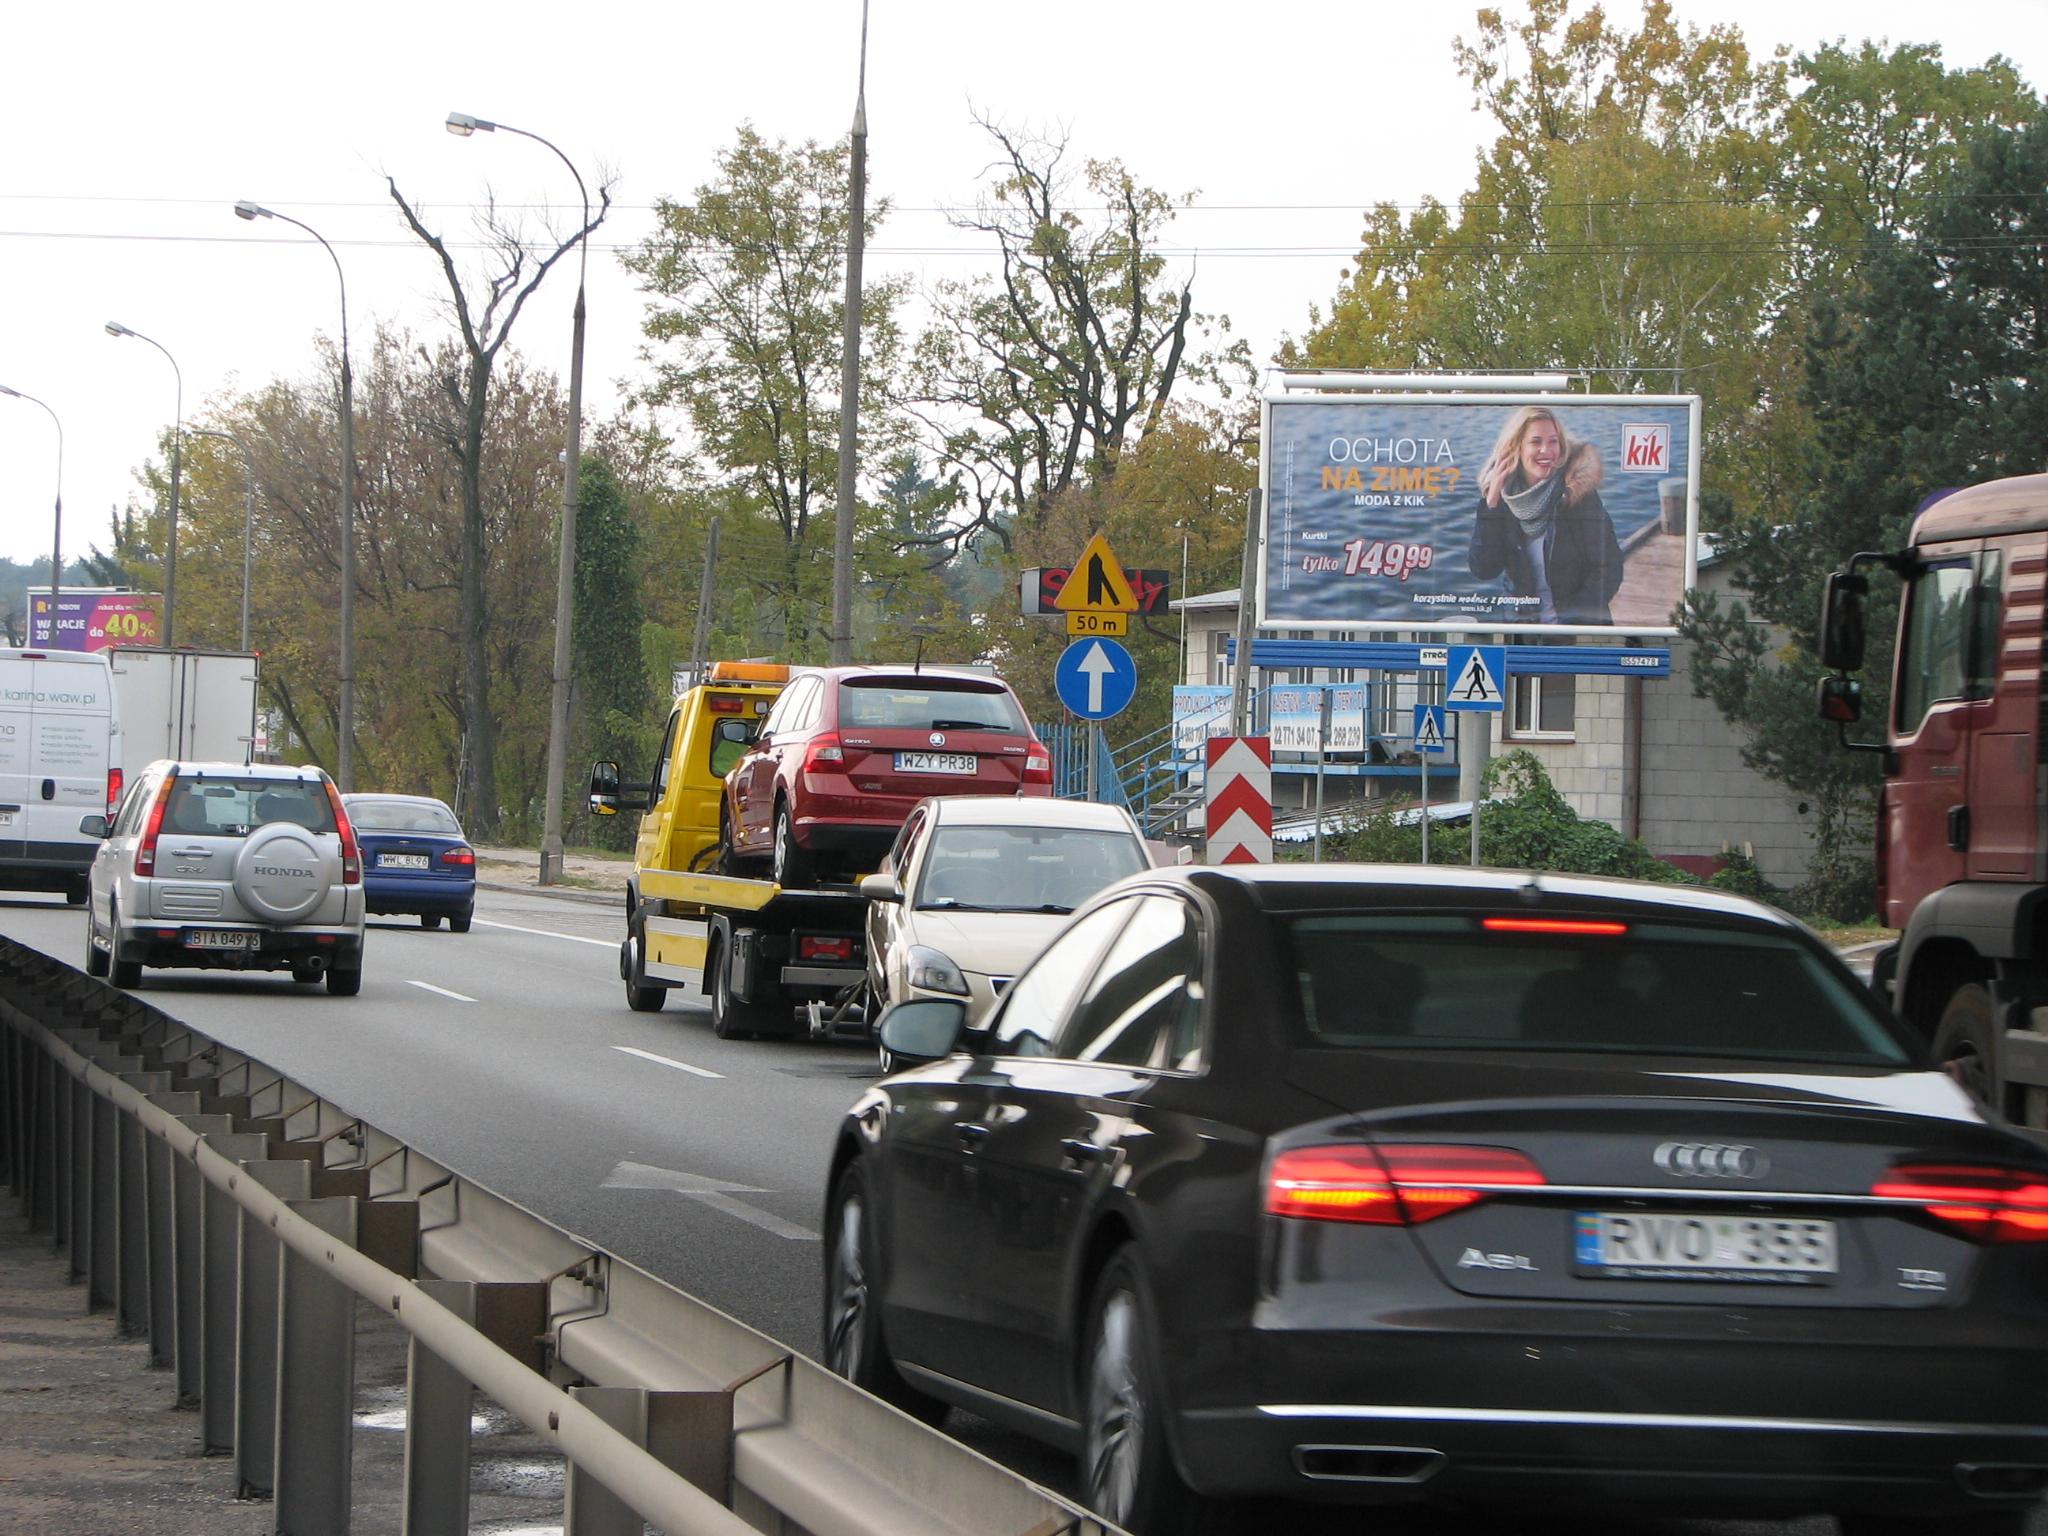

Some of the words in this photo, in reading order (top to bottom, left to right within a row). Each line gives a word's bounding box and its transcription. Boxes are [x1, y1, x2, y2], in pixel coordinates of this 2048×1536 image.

[1329, 437, 1454, 463] OCHOTA
[1626, 430, 1664, 466] kik
[1321, 466, 1363, 490] NA
[1371, 467, 1461, 498] ZIMĘ?
[1354, 495, 1391, 506] MODA
[1393, 496, 1401, 506] Z
[1404, 496, 1425, 506] KIK
[1302, 531, 1328, 540] Kurtki
[1302, 554, 1339, 574] tylko
[1413, 593, 1456, 605] korzystnie
[1490, 597, 1497, 605] z
[1077, 615, 1098, 631] 50
[1103, 621, 1117, 631] m
[89, 626, 104, 638] do
[904, 753, 934, 768] WZY
[939, 755, 975, 770] PR38
[254, 866, 315, 878] HONDA
[193, 931, 217, 945] BIA
[1606, 1216, 1713, 1262] RVO
[1741, 1220, 1831, 1266] 355
